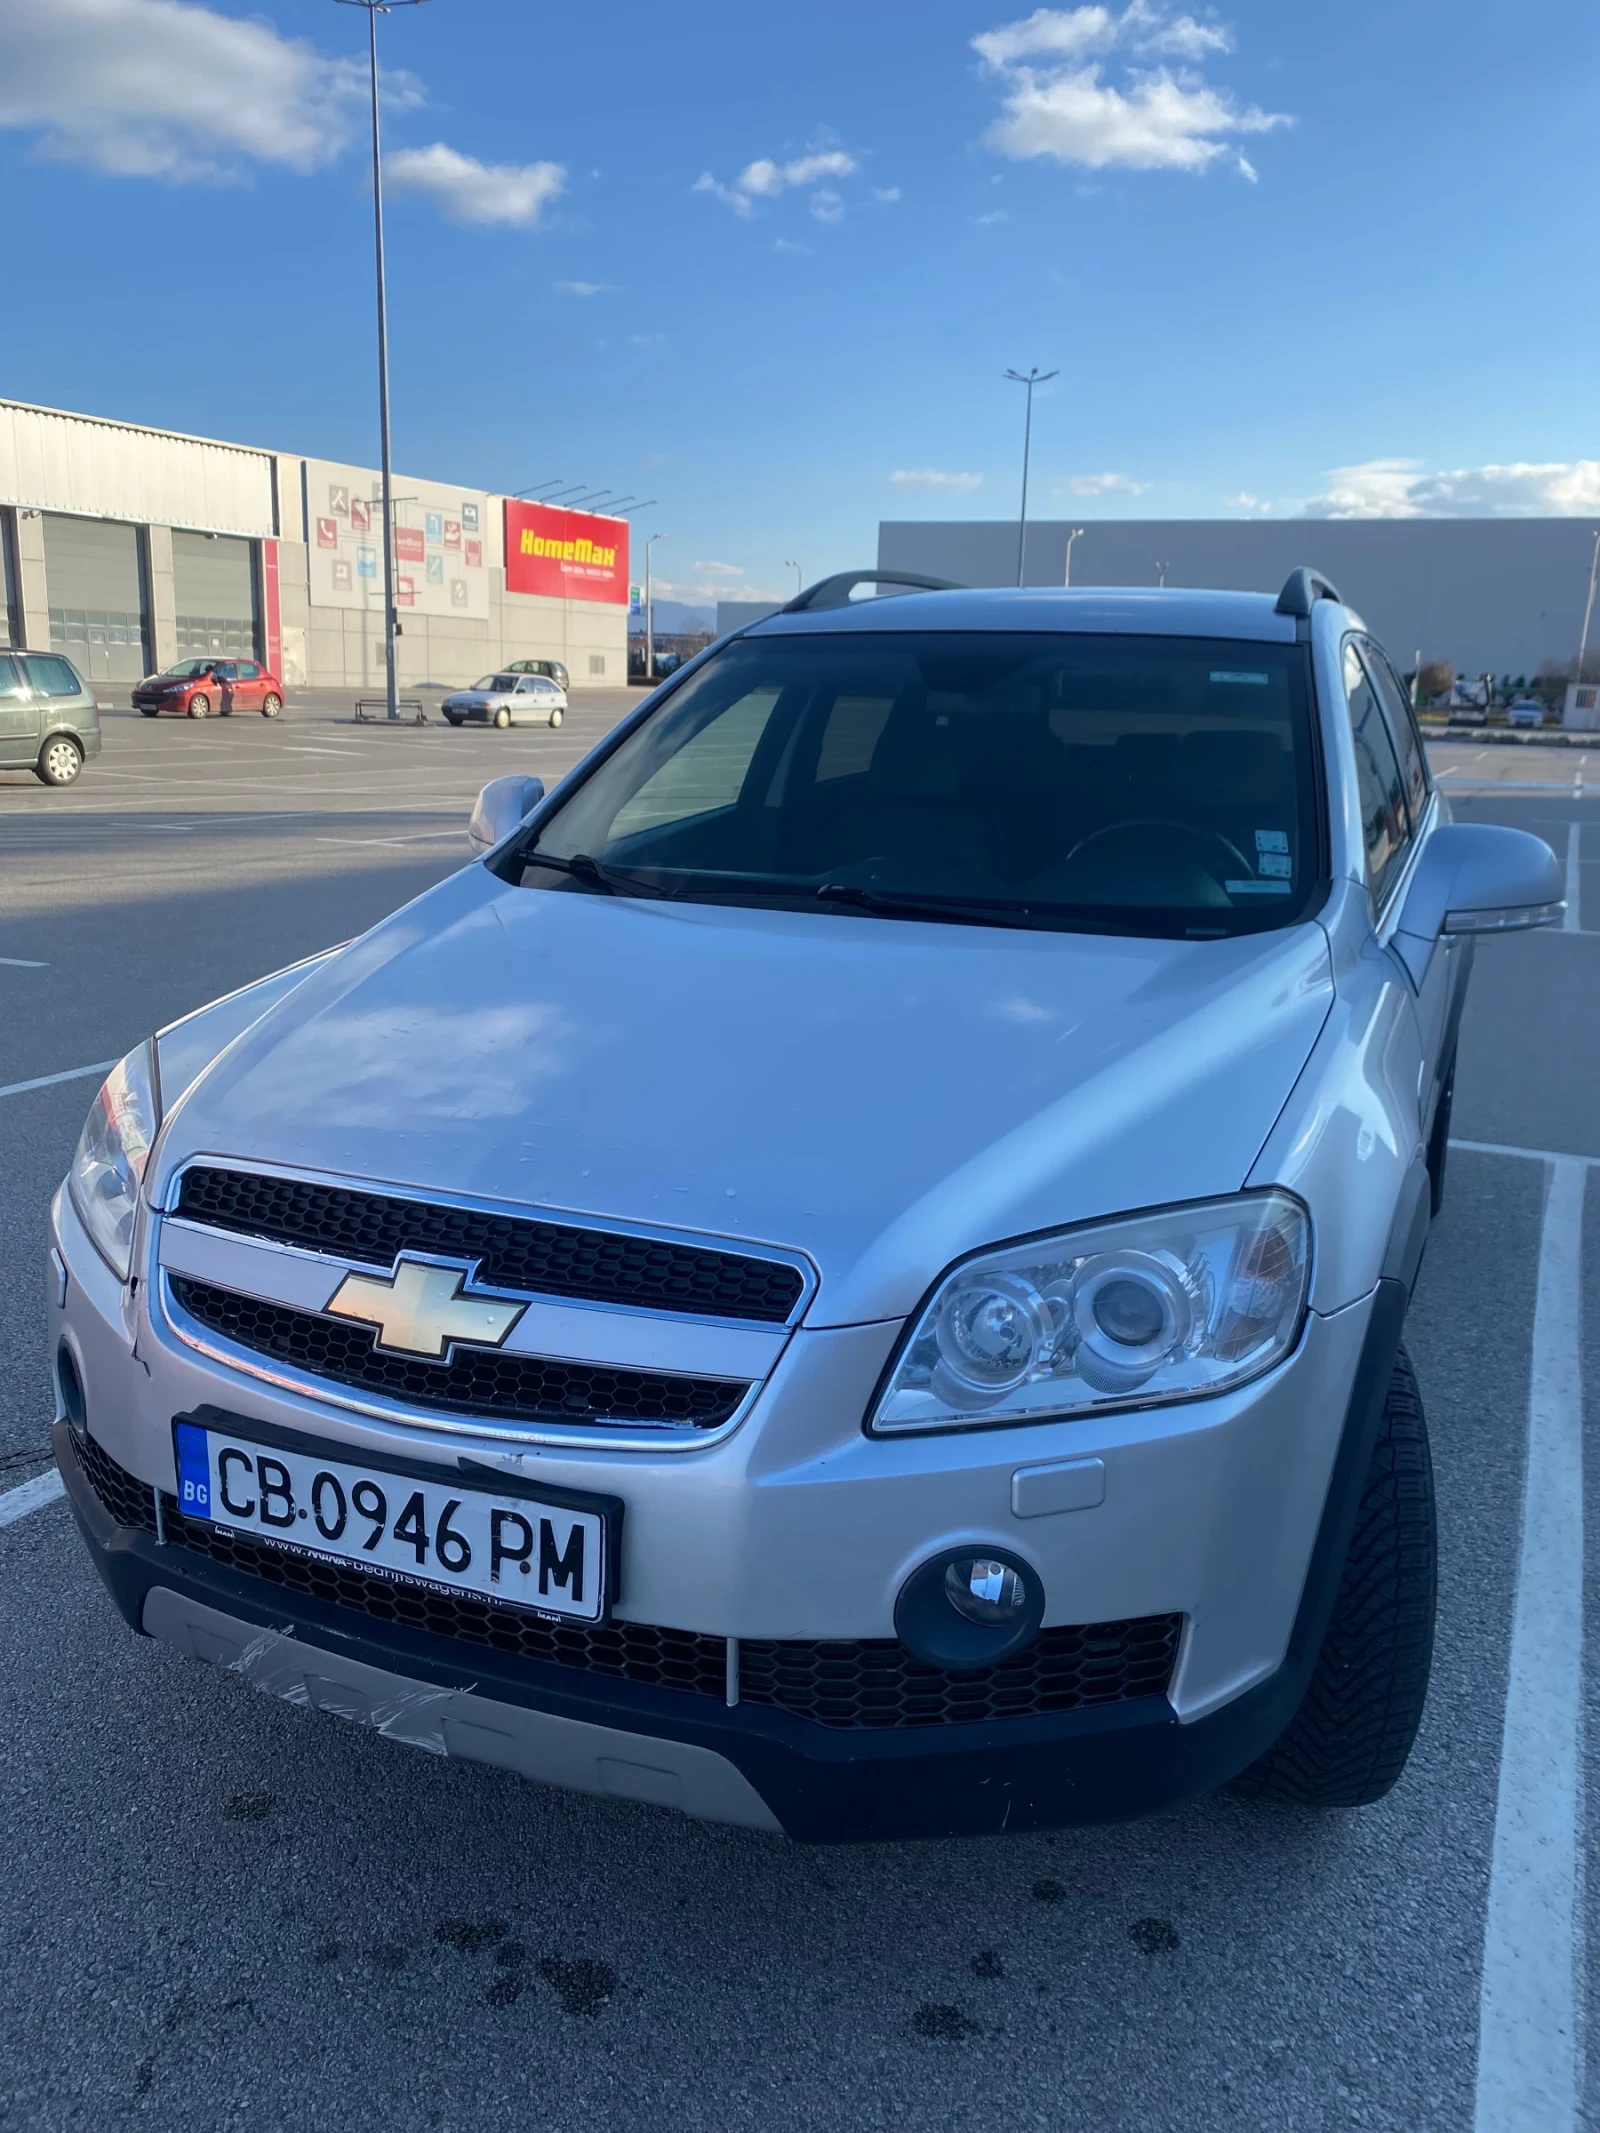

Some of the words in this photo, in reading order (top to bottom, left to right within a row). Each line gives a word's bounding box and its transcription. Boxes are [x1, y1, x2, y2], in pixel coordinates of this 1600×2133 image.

[520, 528, 615, 568] HomeMax
[184, 1480, 208, 1504] BG
[218, 1447, 297, 1527] CB
[311, 1471, 473, 1573] 0946
[490, 1506, 585, 1602] PM
